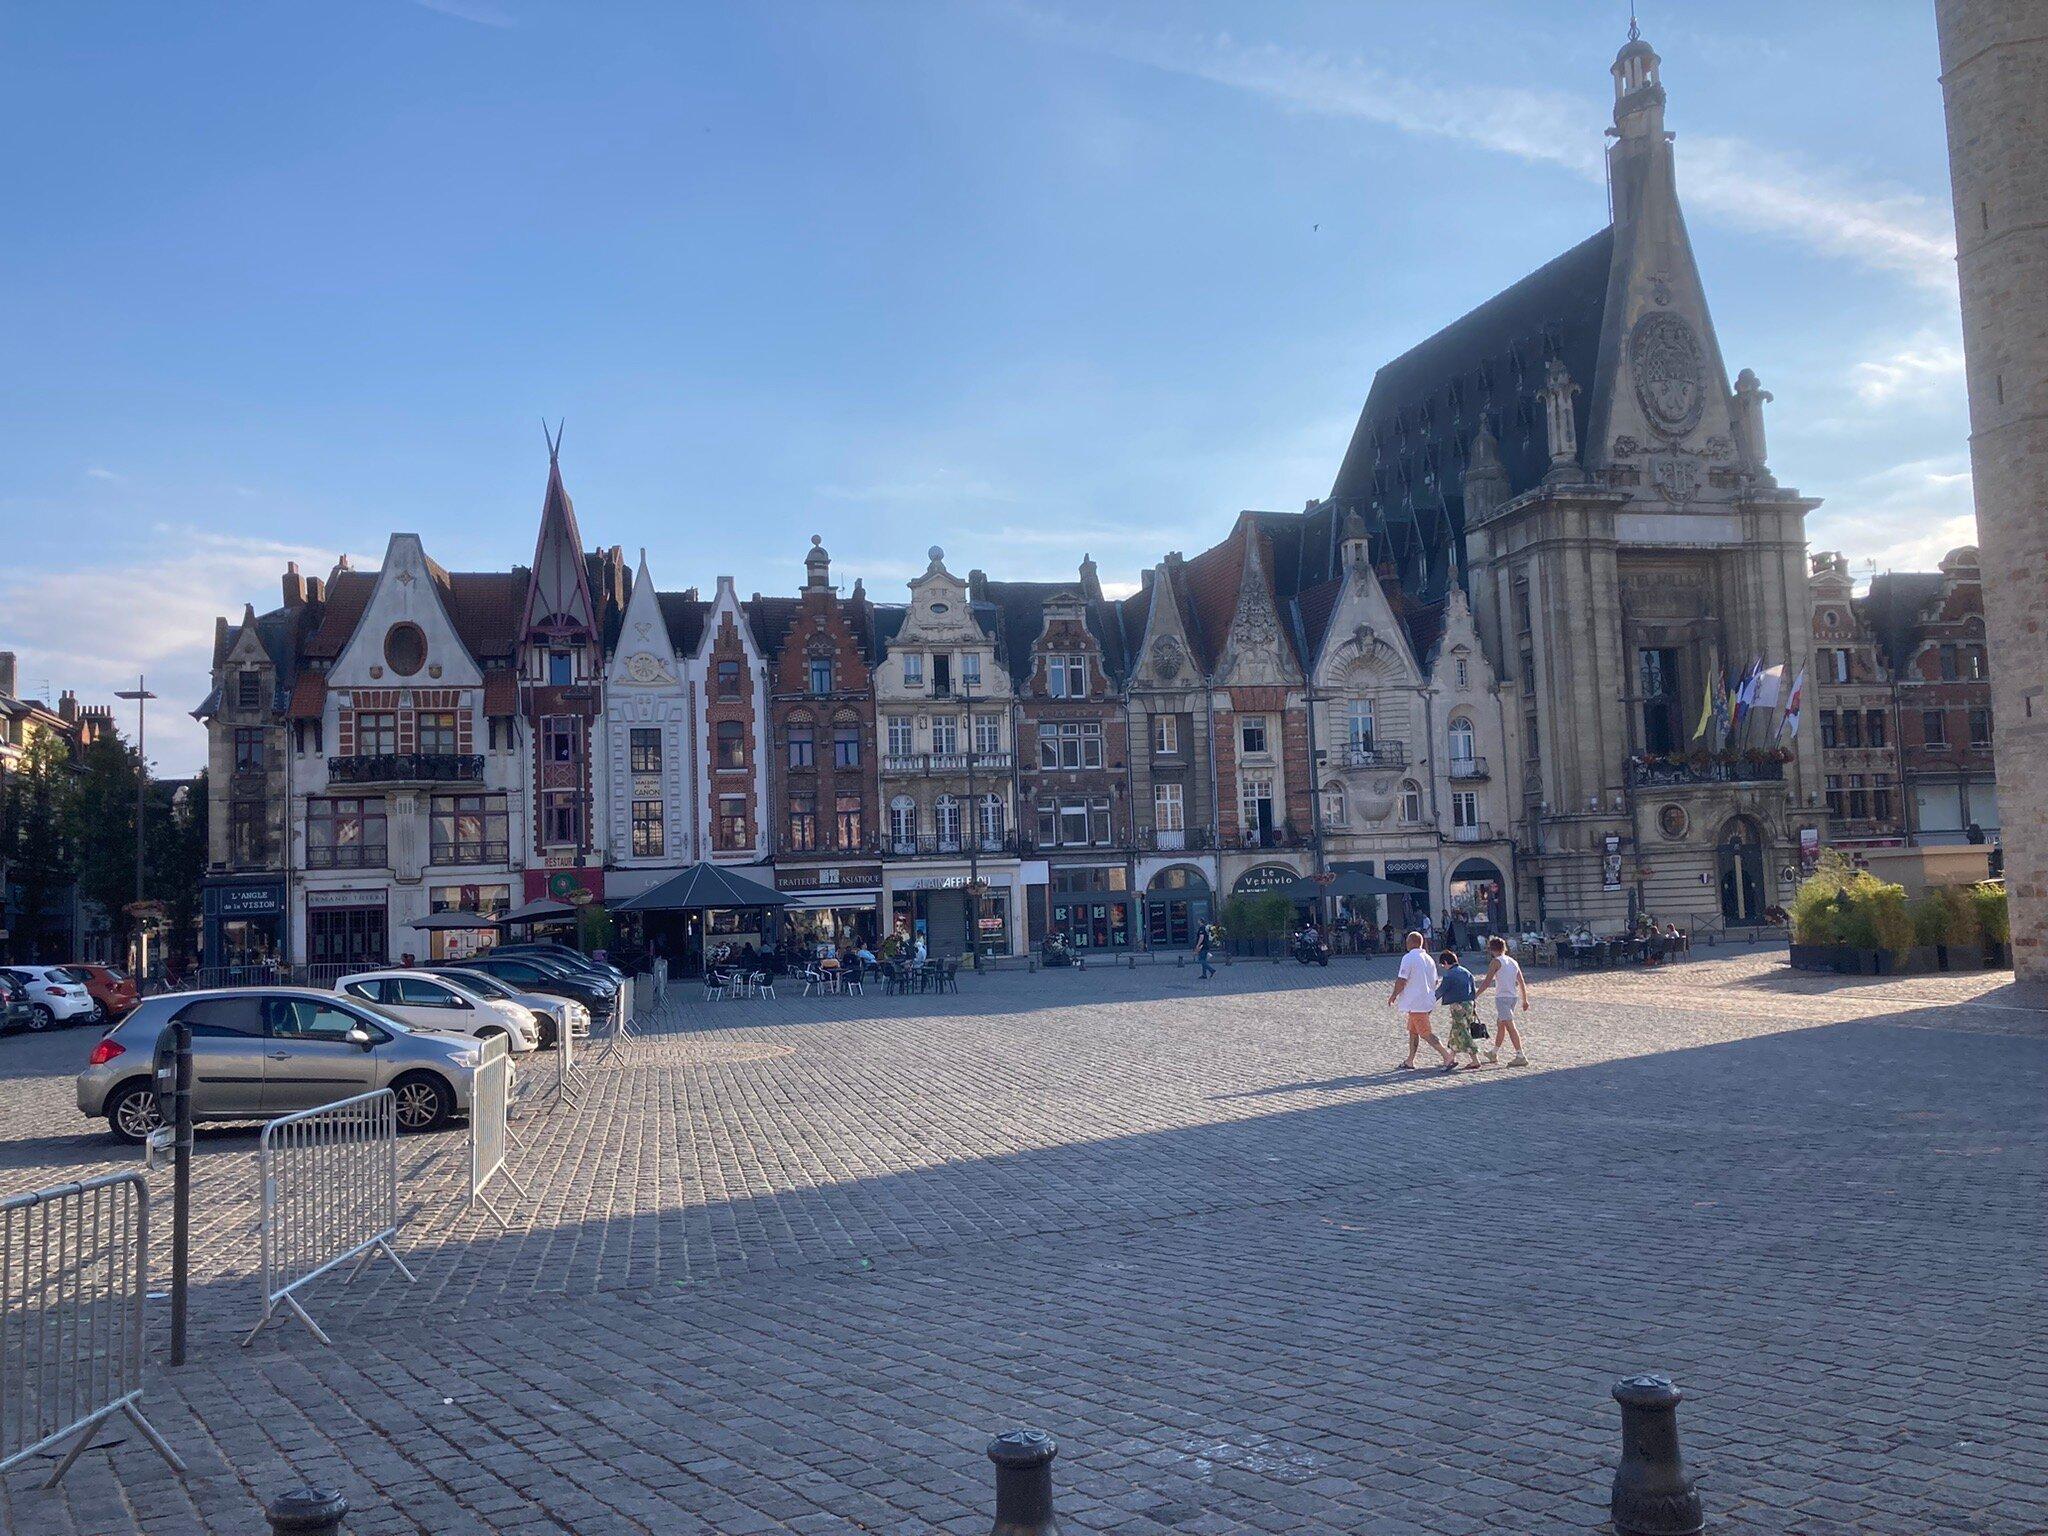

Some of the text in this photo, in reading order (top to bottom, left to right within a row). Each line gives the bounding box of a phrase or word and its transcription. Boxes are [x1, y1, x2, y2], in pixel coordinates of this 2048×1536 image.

[1262, 869, 1275, 877] Le
[777, 875, 879, 886] TRAITEUR ASIATIQUE
[915, 877, 944, 888] ALAIN
[231, 891, 268, 900] L'ANGLE
[242, 900, 275, 909] VISION
